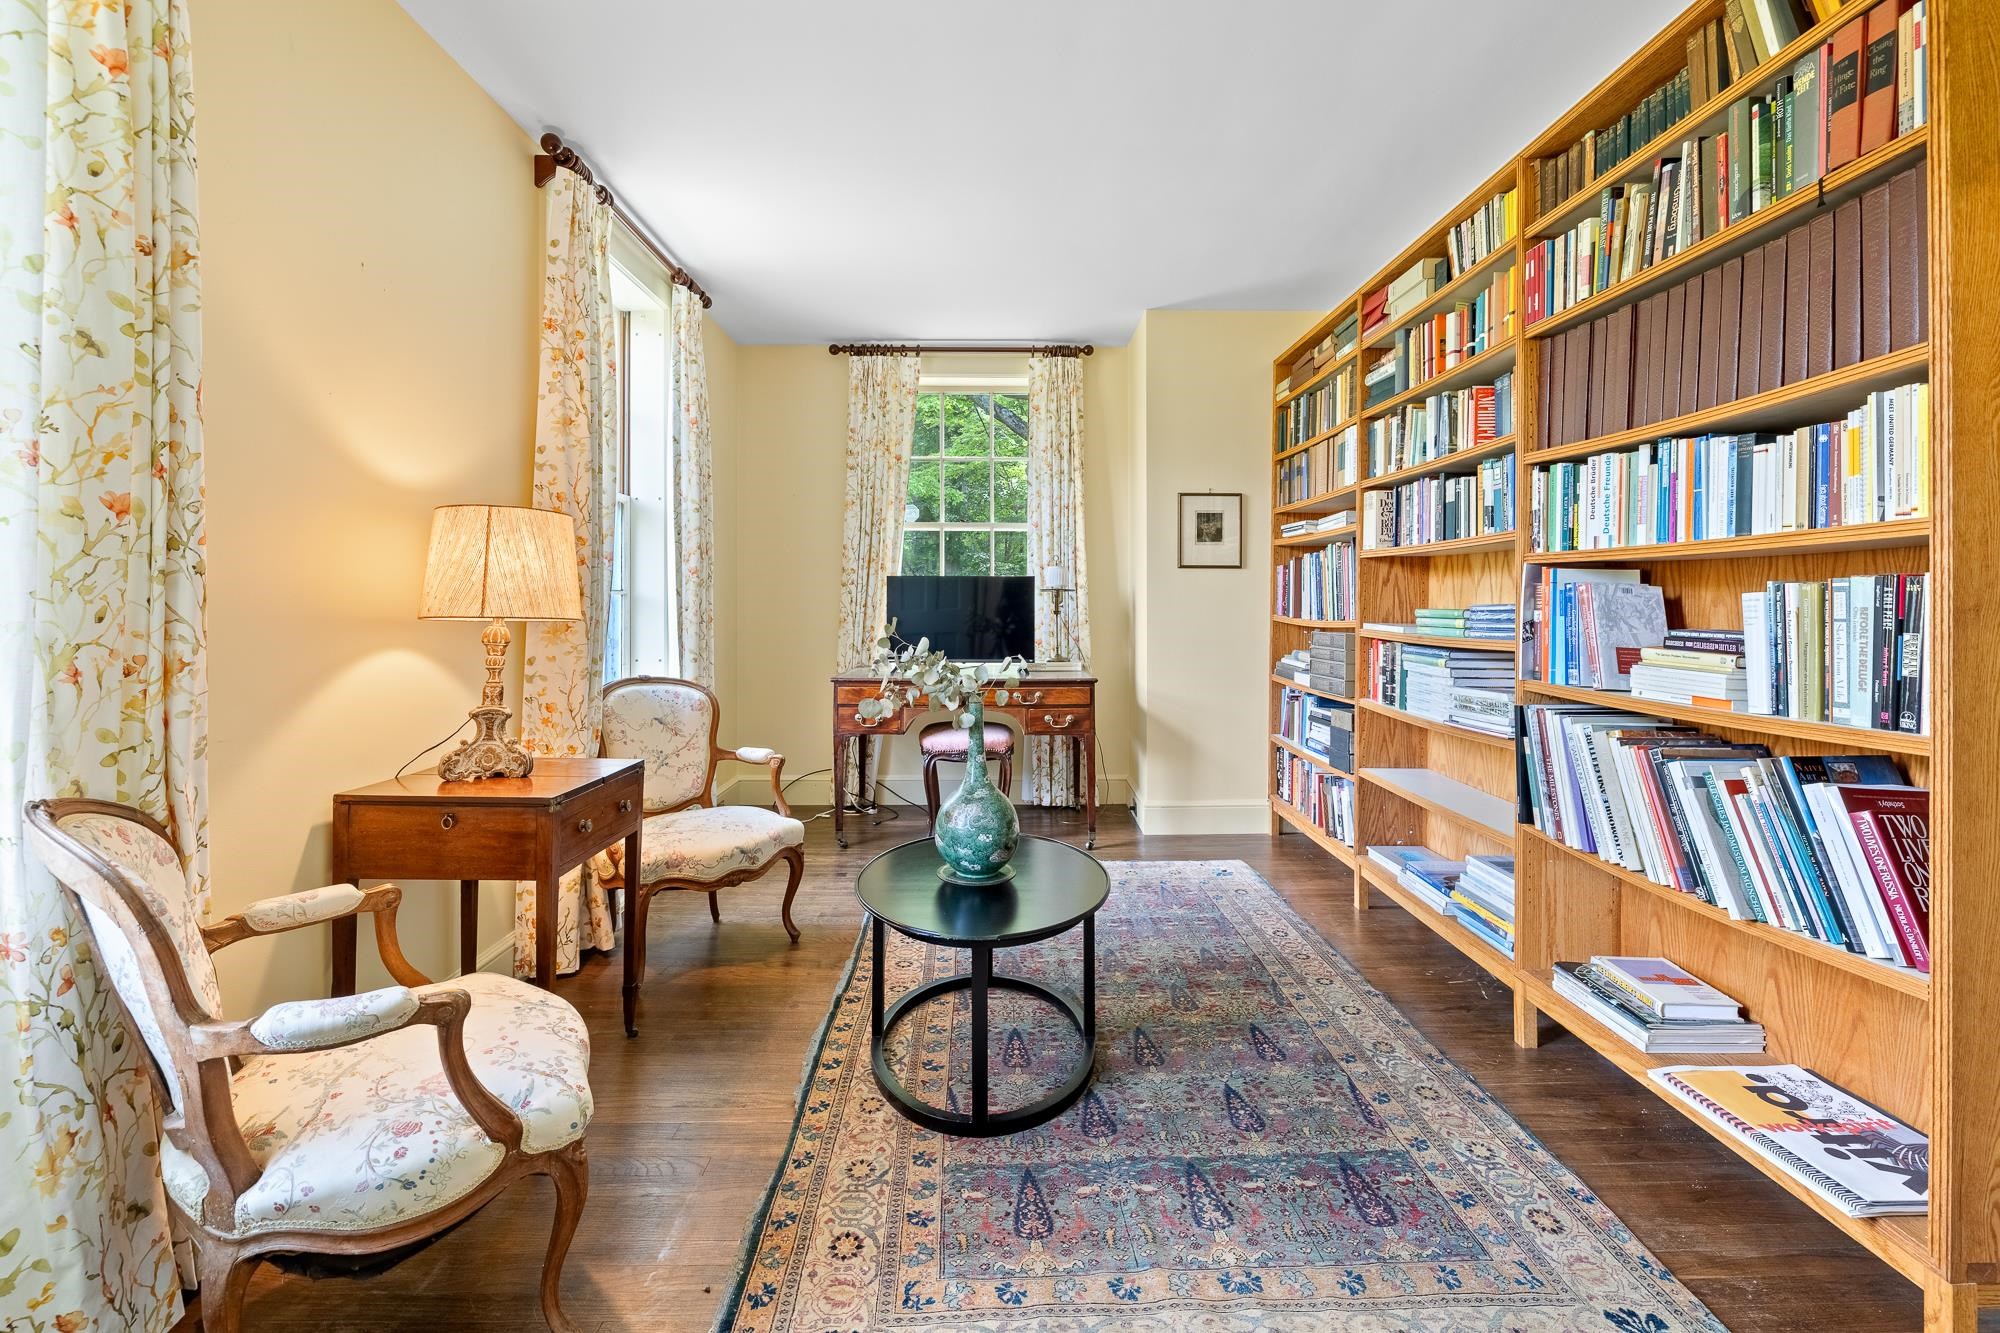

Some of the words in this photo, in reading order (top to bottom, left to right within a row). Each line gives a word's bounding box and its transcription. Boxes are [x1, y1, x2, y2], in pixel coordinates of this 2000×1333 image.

[1872, 53, 1886, 65] the
[1834, 69, 1855, 85] Hinge
[1869, 64, 1889, 80] Ring
[1839, 81, 1857, 96] Fate
[1776, 99, 1784, 120] ROTH
[1667, 185, 1682, 232] Ginsberg
[1602, 493, 1610, 534] Deutsche
[1860, 606, 1869, 641] BEFORE
[1883, 611, 1893, 631] PEACE
[1718, 644, 1737, 652] HITLER
[1834, 623, 1843, 656] Sketches
[1859, 641, 1868, 658] THE
[1902, 639, 1910, 671] WILD
[1909, 634, 1919, 678] BERLIN
[1858, 659, 1867, 693] DELUGE
[1583, 732, 1601, 775] CULTURE
[1794, 762, 1825, 773] NAIVE
[1800, 772, 1817, 782] ART
[1545, 757, 1553, 772] THE
[1549, 773, 1560, 821] MILESTONES
[1597, 775, 1607, 796] AND
[1877, 800, 1906, 809] Sotheby's
[1602, 796, 1624, 862] AUTOMOBILE
[1878, 814, 1928, 840] TWO
[1704, 774, 1725, 819] DEUTSCHES
[1719, 818, 1747, 874] JAGDMUSEUM
[1743, 873, 1764, 920] MÜNCHEN
[1857, 819, 1871, 837] TWO
[1880, 871, 1900, 900] RUSSIA
[1894, 903, 1913, 933] NICHOLAS
[1905, 932, 1924, 961] DANILOFF
[1757, 1116, 1899, 1136] workspirit
